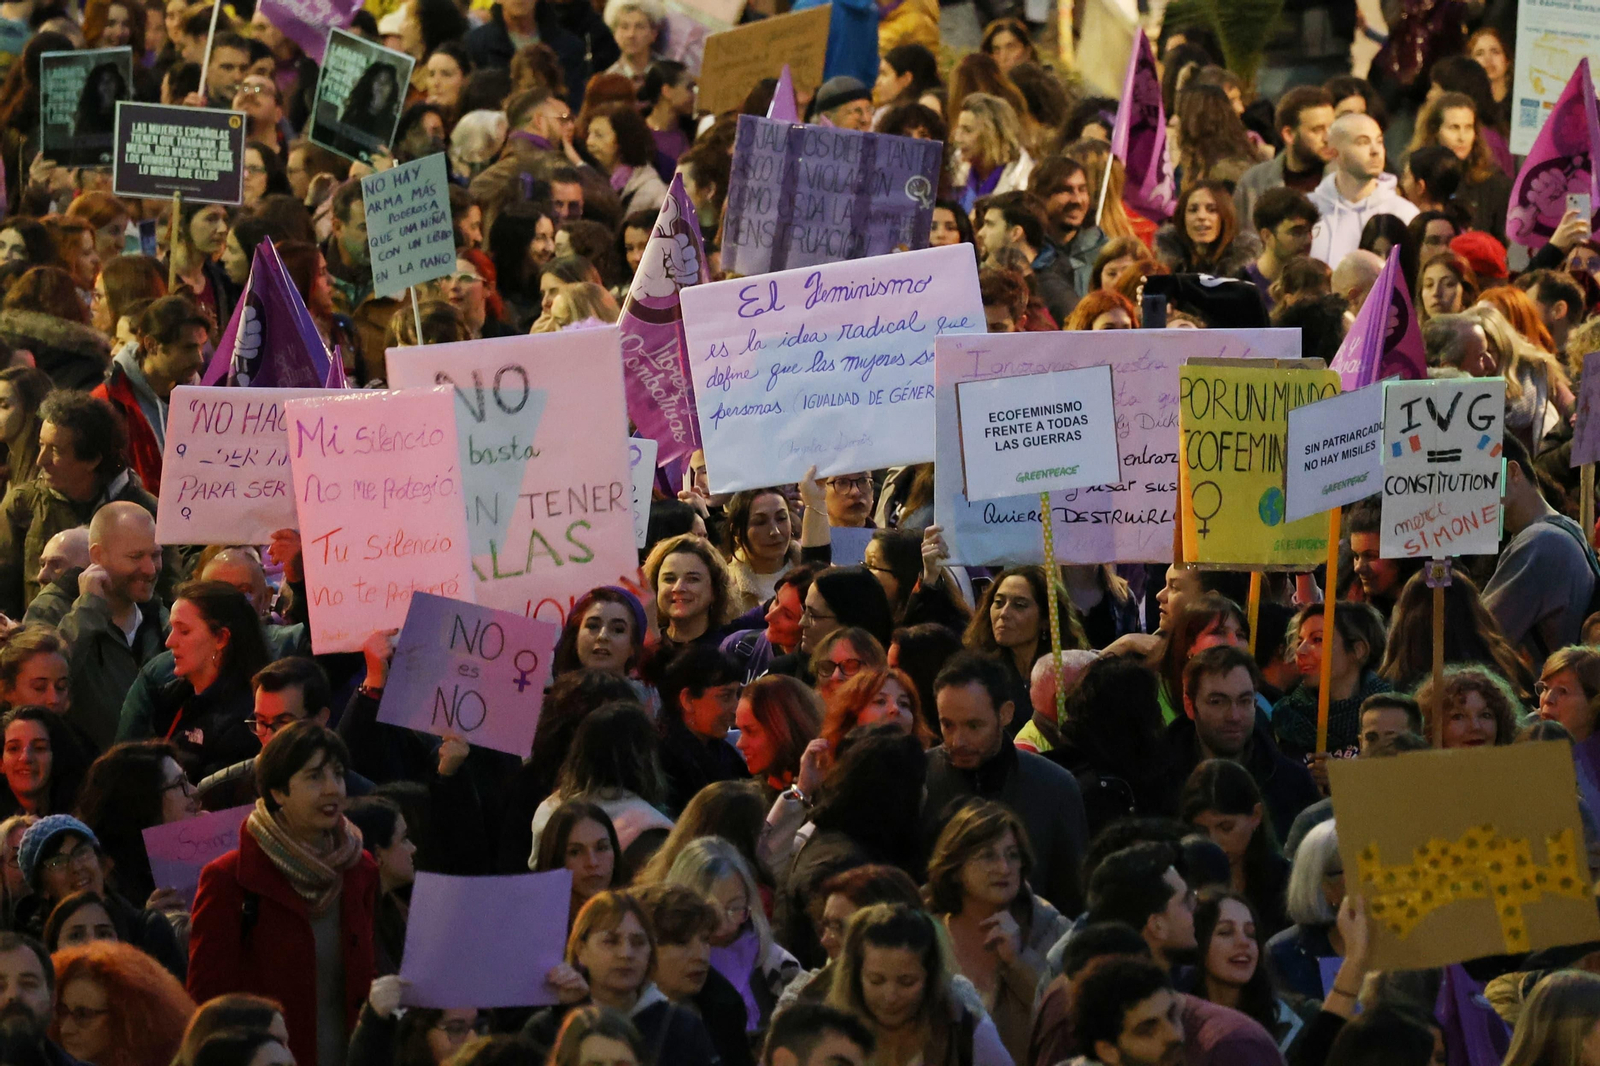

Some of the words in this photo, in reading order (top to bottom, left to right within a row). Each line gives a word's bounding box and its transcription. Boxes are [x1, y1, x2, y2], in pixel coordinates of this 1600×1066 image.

[132, 122, 147, 134] LAS
[148, 123, 183, 137] MUJERES
[125, 153, 140, 164] LOS
[180, 157, 201, 169] PARA
[171, 146, 198, 159] MESES
[139, 164, 149, 175] LO
[150, 165, 177, 178] MISMO
[178, 168, 193, 179] QUE
[194, 169, 219, 181] ELLOS
[365, 178, 386, 198] NO
[393, 164, 421, 189] HAY
[366, 194, 404, 216] ARMA
[411, 178, 437, 201] MÁS
[388, 200, 439, 224] PODEROSA
[370, 230, 394, 248] QUE
[399, 222, 417, 237] UNA
[378, 245, 401, 262] CON
[408, 237, 422, 250] UN
[375, 269, 389, 284] EN
[398, 262, 414, 275] LA
[420, 252, 452, 269] MANO
[738, 280, 785, 318] El
[704, 341, 729, 361] es
[739, 329, 767, 355] la
[778, 323, 828, 349] idea
[836, 310, 926, 342] radical
[936, 316, 976, 335] que
[706, 366, 759, 392] define
[766, 362, 803, 392] que
[805, 350, 836, 373] las
[841, 353, 906, 382] mujeres
[868, 389, 884, 406] DE
[988, 400, 1083, 423] ECOFEMINISMO
[1180, 377, 1233, 420] POR
[1235, 382, 1267, 421] UN
[1400, 391, 1496, 434] IVG
[296, 417, 345, 458] Mi
[353, 424, 444, 454] Silencio
[984, 422, 1033, 439] FRENTE
[1036, 420, 1045, 432] A
[1047, 414, 1089, 430] TODAS
[994, 438, 1019, 452] LAS
[1022, 430, 1082, 448] GUERRAS
[469, 435, 540, 465] basta
[1184, 430, 1286, 474] COFEMIN
[1304, 441, 1320, 456] SIN
[1304, 459, 1318, 471] NO
[1320, 452, 1339, 467] HAY
[1341, 440, 1376, 460] MISILES
[177, 475, 237, 503] PARA
[243, 480, 286, 498] SER
[1015, 464, 1080, 484] GREENPEACE
[519, 481, 627, 519] TENER
[1394, 502, 1449, 536] merci
[1404, 504, 1498, 556] SIMONE
[312, 527, 348, 565] Tu
[364, 530, 451, 560] Silencio
[352, 576, 377, 604] te
[450, 613, 504, 661] NO
[458, 664, 479, 678] es
[431, 684, 487, 732] NO
